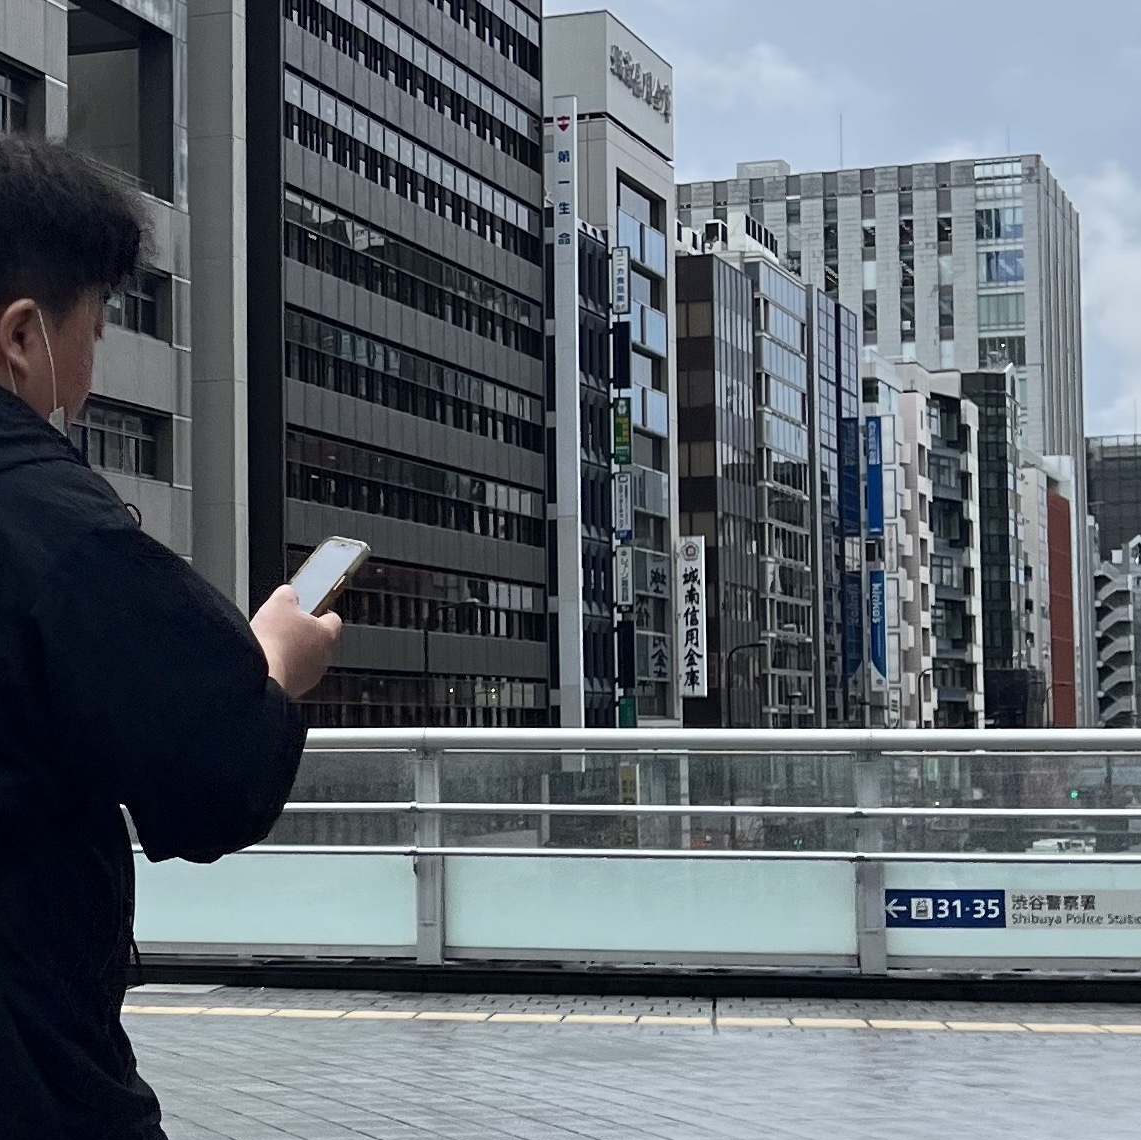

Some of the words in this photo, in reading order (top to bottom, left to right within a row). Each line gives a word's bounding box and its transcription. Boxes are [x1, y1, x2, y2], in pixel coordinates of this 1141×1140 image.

[558, 150, 571, 245] 第一生命
[871, 582, 883, 624] kinko's
[682, 566, 704, 694] 城南信用金庫
[1011, 894, 1096, 911] 渋谷警察署
[1011, 913, 1062, 926] Shibuya
[1066, 913, 1104, 924] Police
